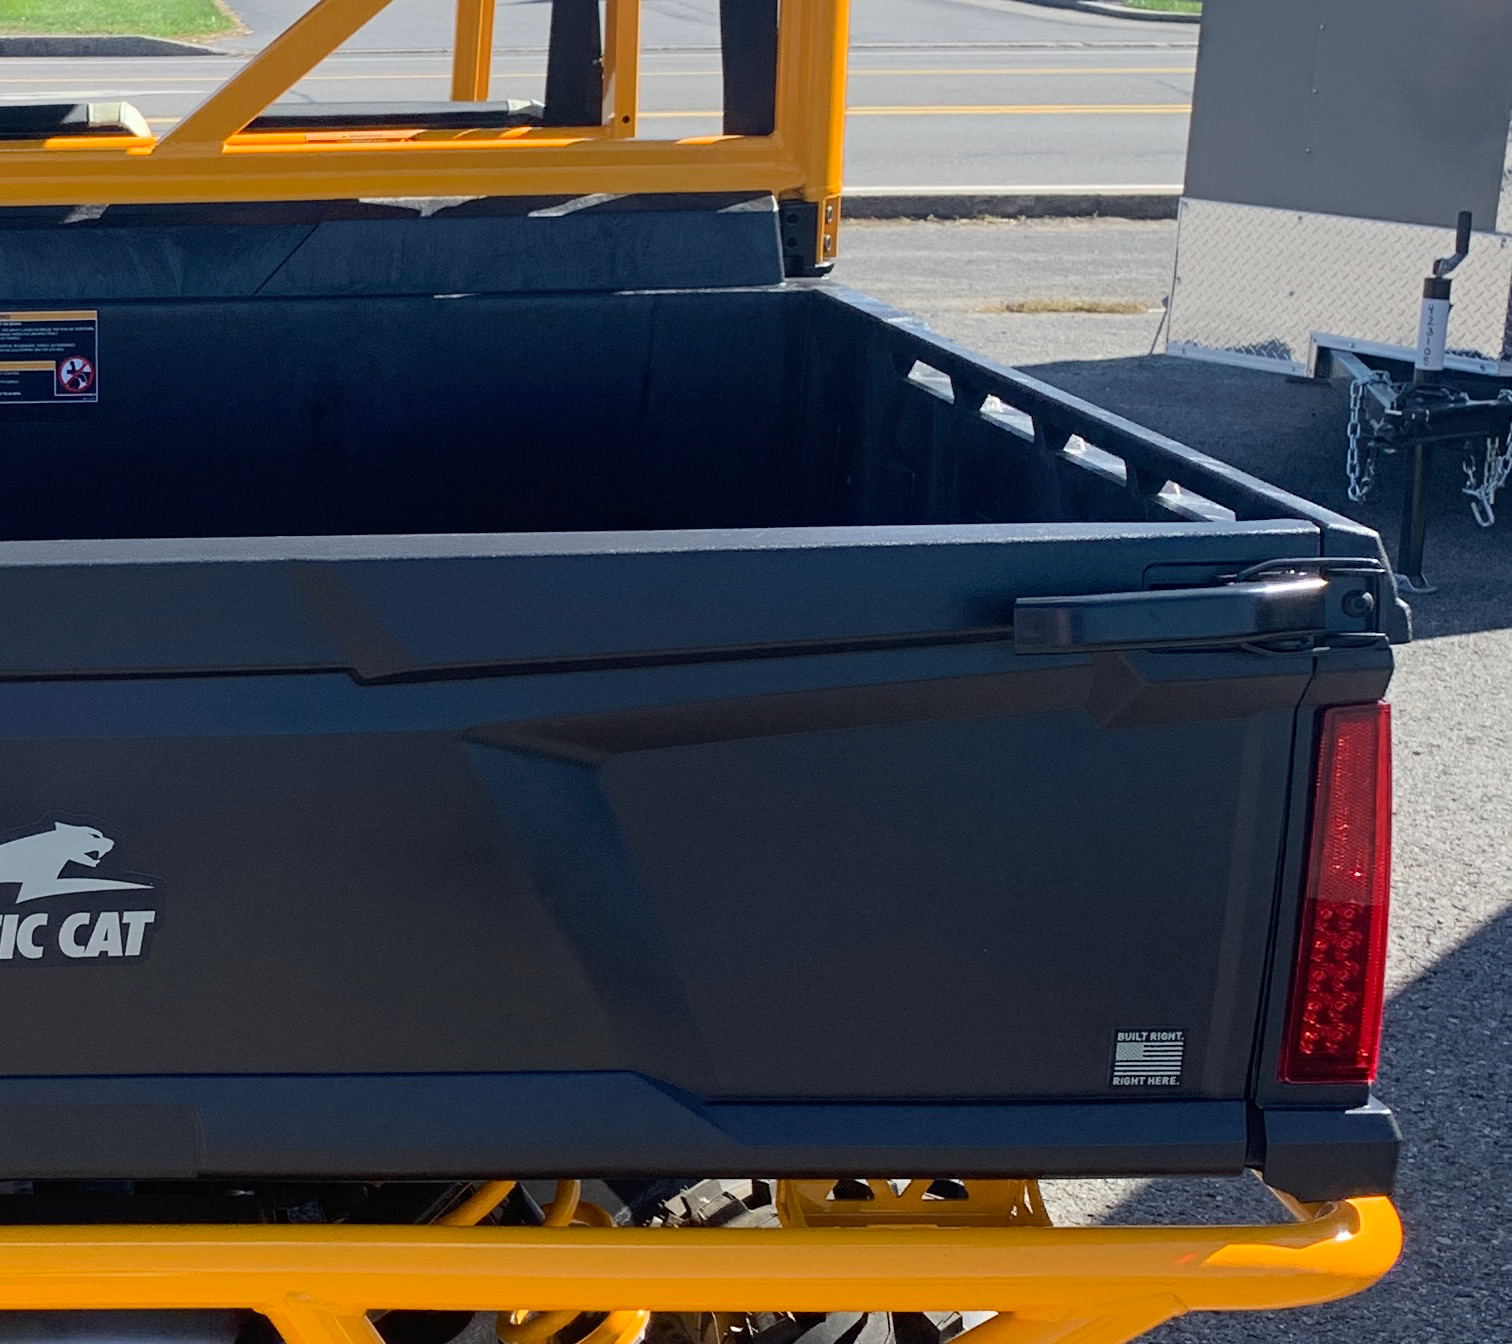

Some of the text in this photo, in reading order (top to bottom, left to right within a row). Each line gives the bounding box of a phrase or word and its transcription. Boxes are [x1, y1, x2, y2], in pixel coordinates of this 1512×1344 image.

[1423, 304, 1434, 366] 423105
[58, 910, 156, 959] CAT
[1117, 1031, 1185, 1041] BUILT RIGHT.
[1112, 1076, 1180, 1086] RIGHT HERE.
